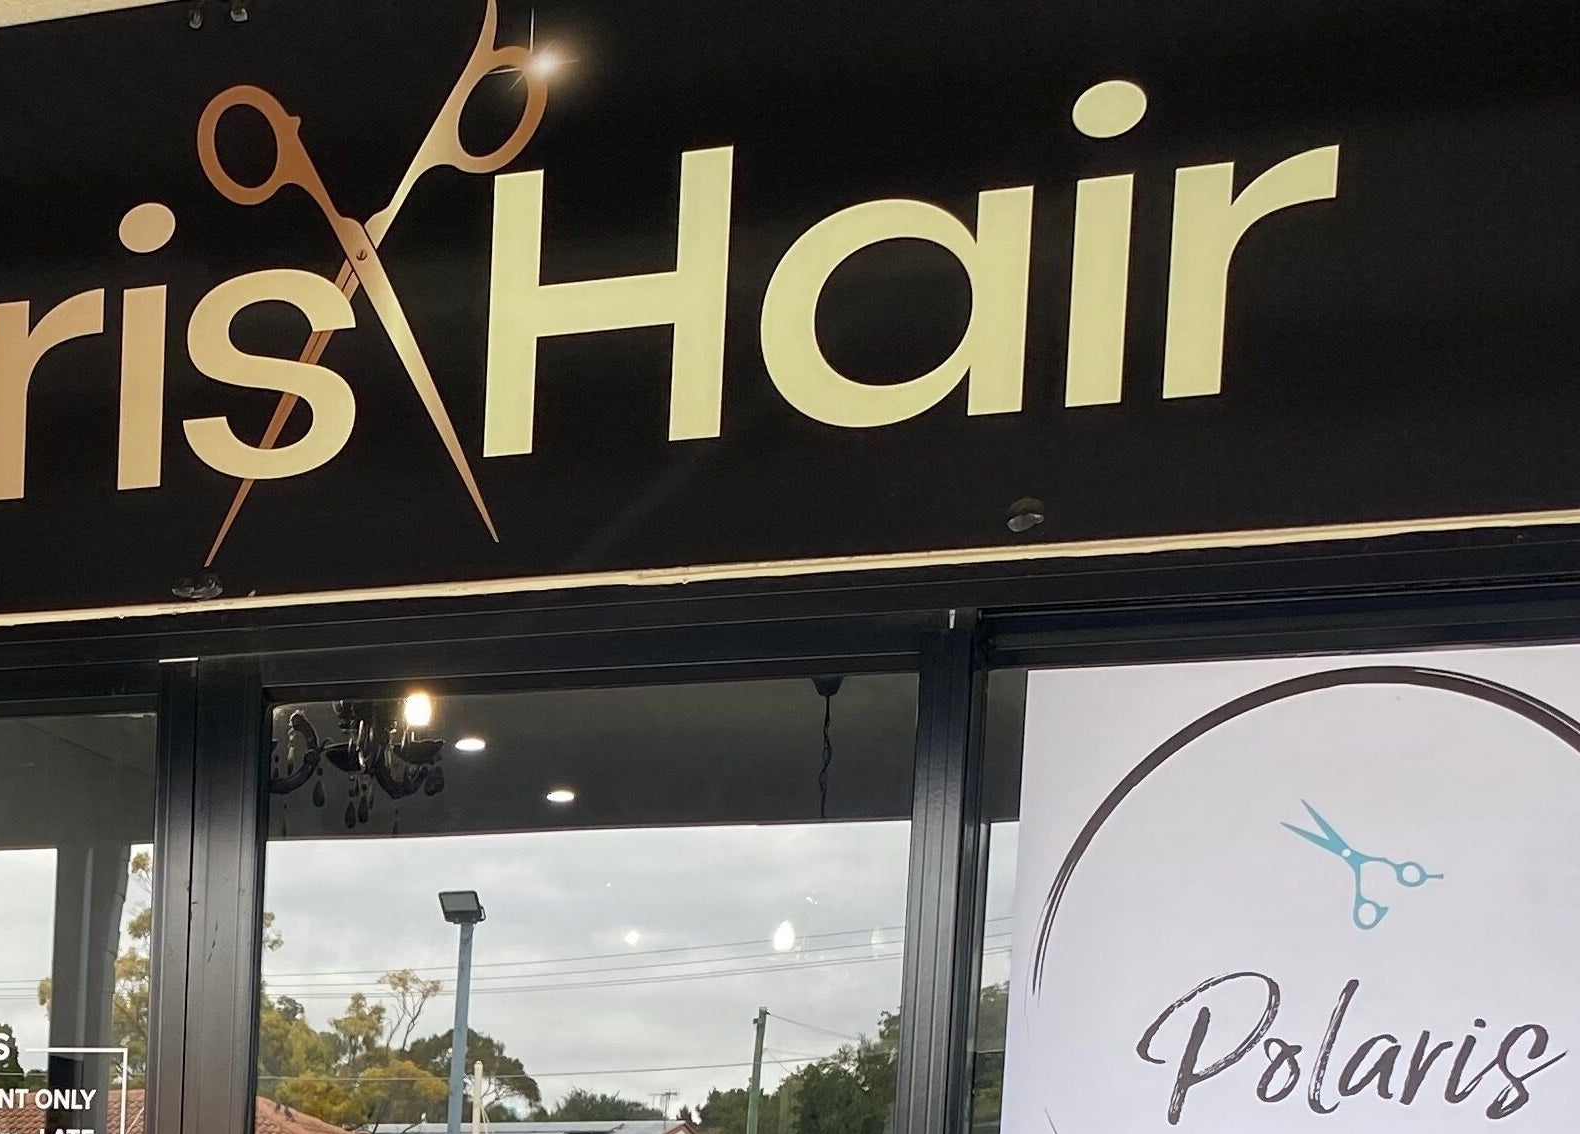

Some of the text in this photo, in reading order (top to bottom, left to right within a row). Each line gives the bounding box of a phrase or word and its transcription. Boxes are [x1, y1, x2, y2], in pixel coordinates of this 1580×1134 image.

[481, 79, 1340, 459] Hair
[35, 1089, 96, 1111] ONLY
[1136, 970, 1569, 1126] Polaris
